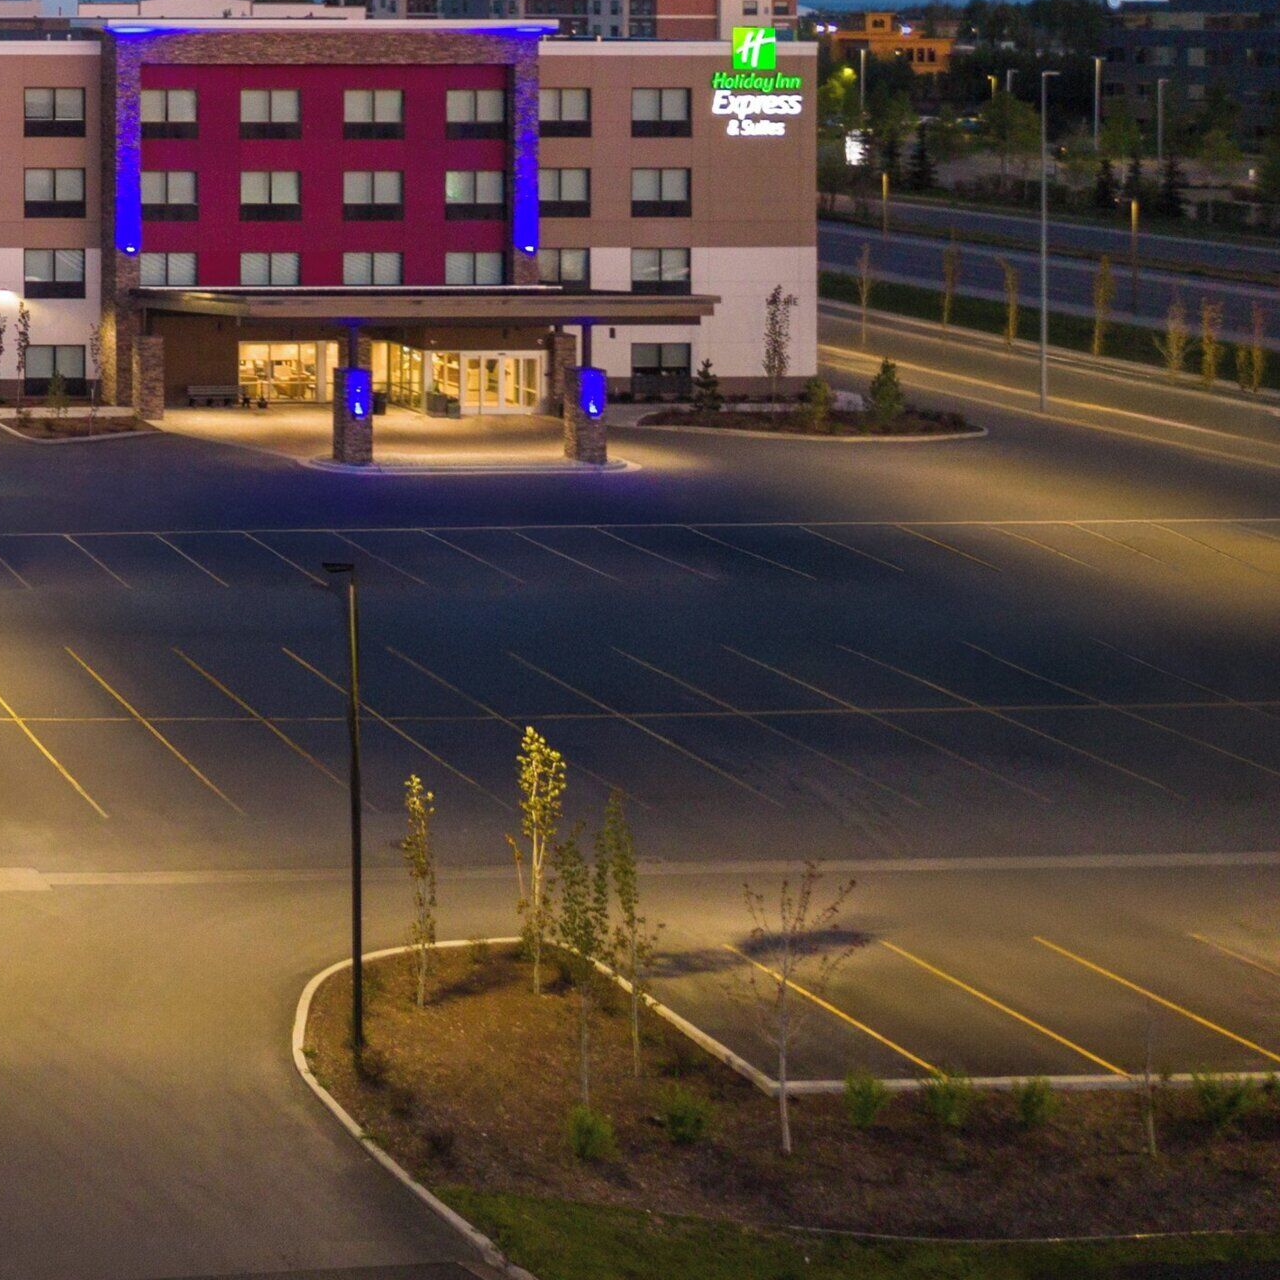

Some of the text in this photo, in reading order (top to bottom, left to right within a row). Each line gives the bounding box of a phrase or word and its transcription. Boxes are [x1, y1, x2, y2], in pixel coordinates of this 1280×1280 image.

[712, 72, 801, 92] Holiday Inn
[712, 90, 802, 120] Express
[727, 120, 785, 135] & Suites
